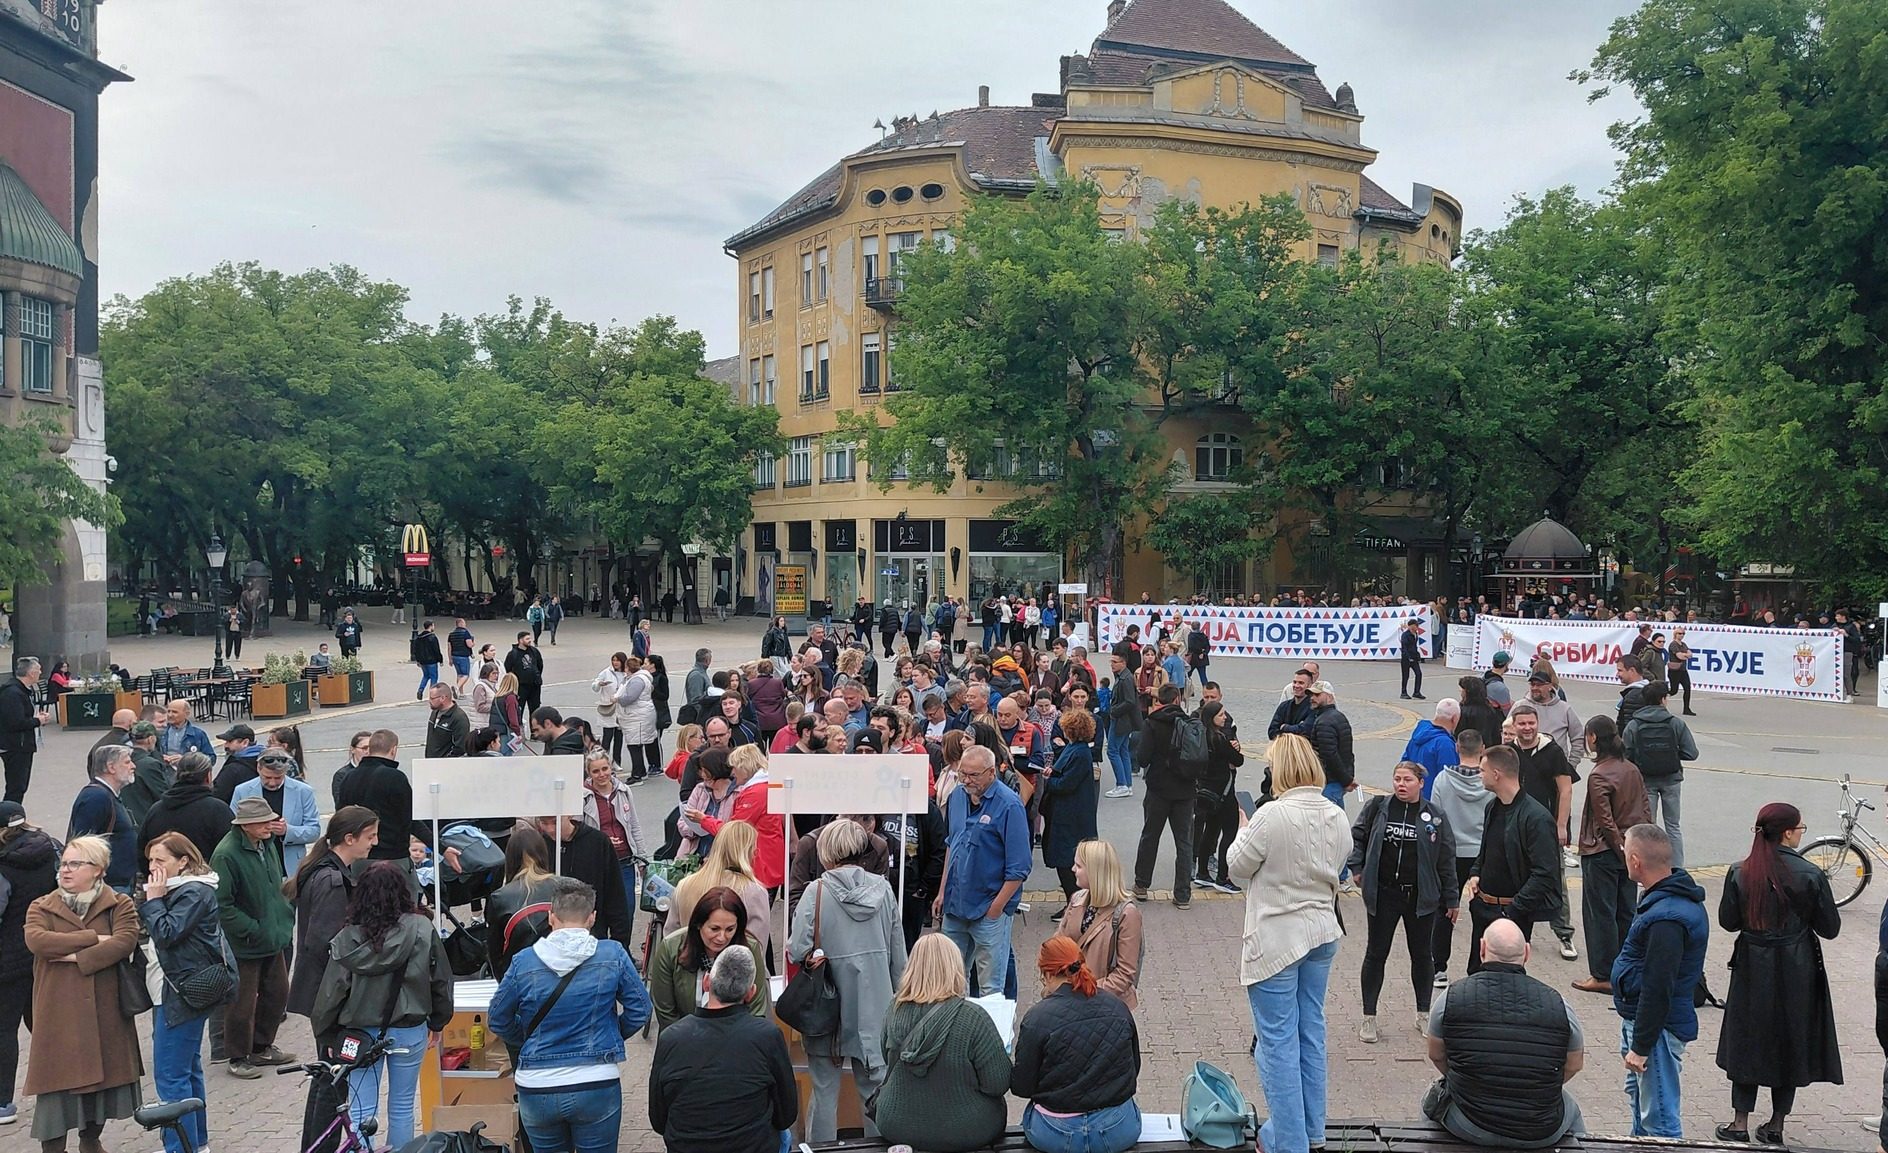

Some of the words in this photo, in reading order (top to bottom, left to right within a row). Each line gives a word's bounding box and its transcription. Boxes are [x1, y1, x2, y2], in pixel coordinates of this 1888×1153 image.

[62, 10, 79, 32] 10
[1365, 537, 1406, 548] TIFFAN
[1247, 622, 1380, 644] ПОБЕЂУЈЕ
[343, 1039, 360, 1051] FCK
[341, 1046, 358, 1058] SNS
